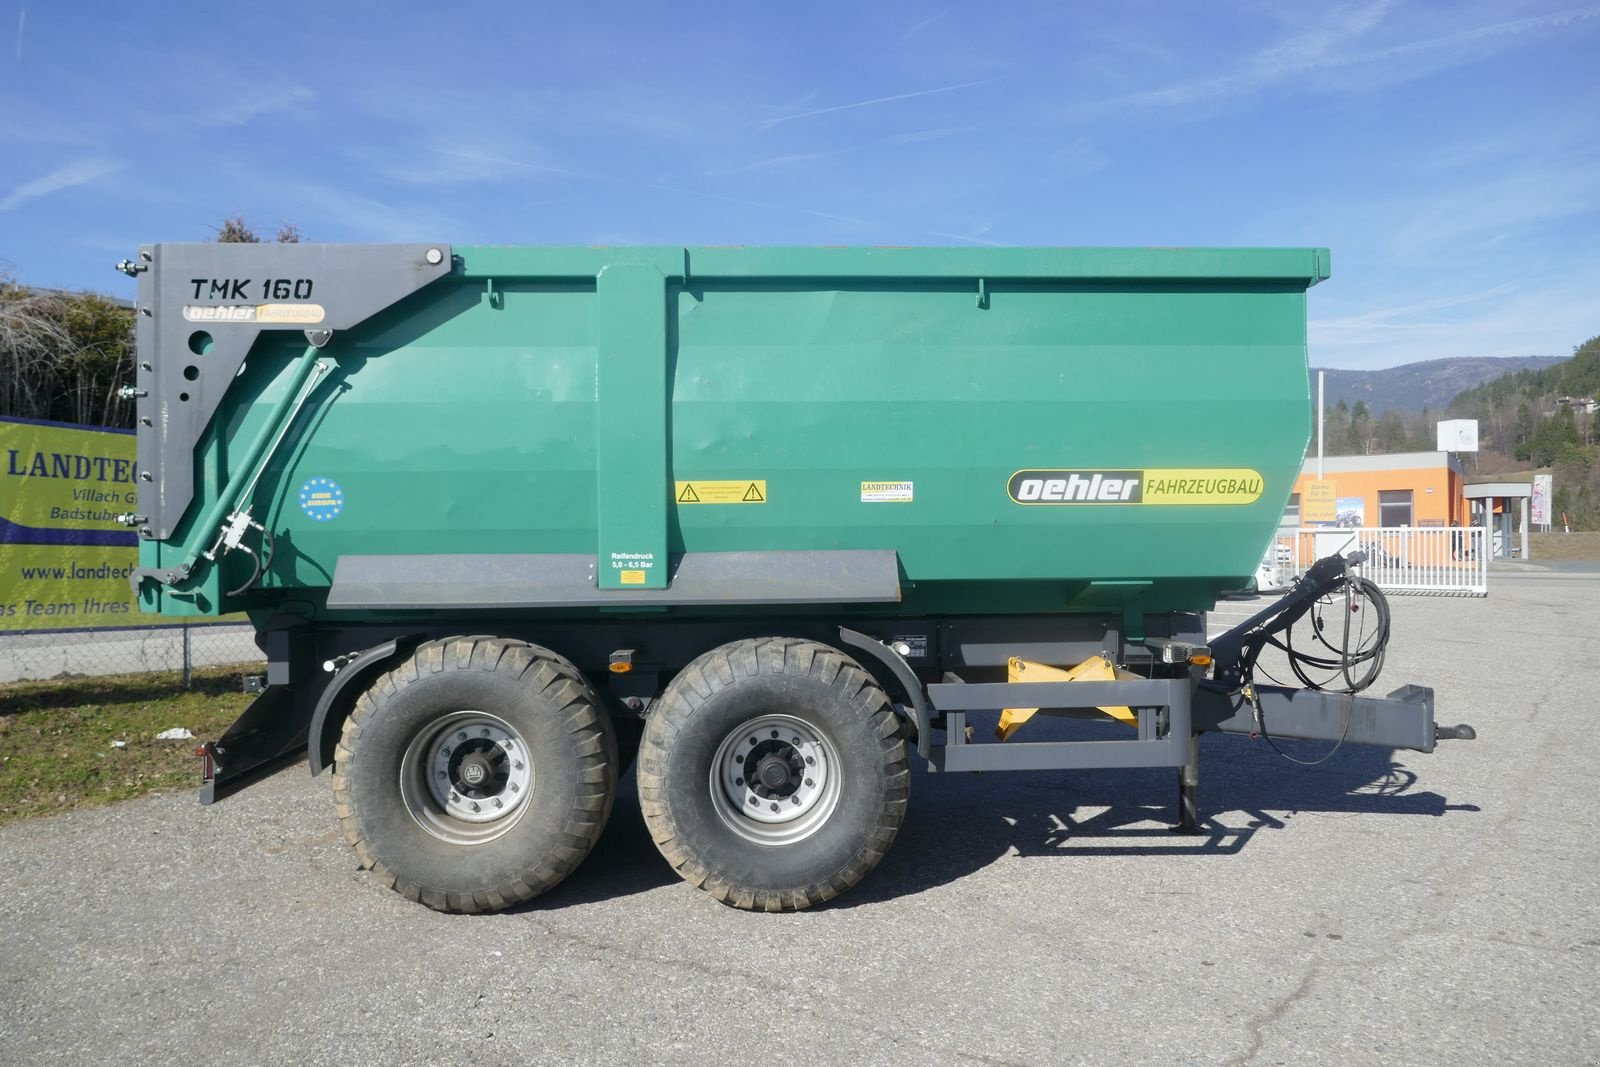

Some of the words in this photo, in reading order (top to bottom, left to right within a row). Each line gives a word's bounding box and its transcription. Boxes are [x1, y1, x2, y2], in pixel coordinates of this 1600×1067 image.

[191, 279, 251, 299] TMK
[262, 279, 313, 299] 160
[189, 305, 255, 320] oehler
[1017, 474, 1139, 500] oehler
[1146, 479, 1260, 494] FAHRZEUGBAU
[73, 489, 119, 503] Villach
[611, 552, 654, 560] Reifendruck
[25, 600, 76, 615] Team
[83, 599, 129, 614] Ihres
